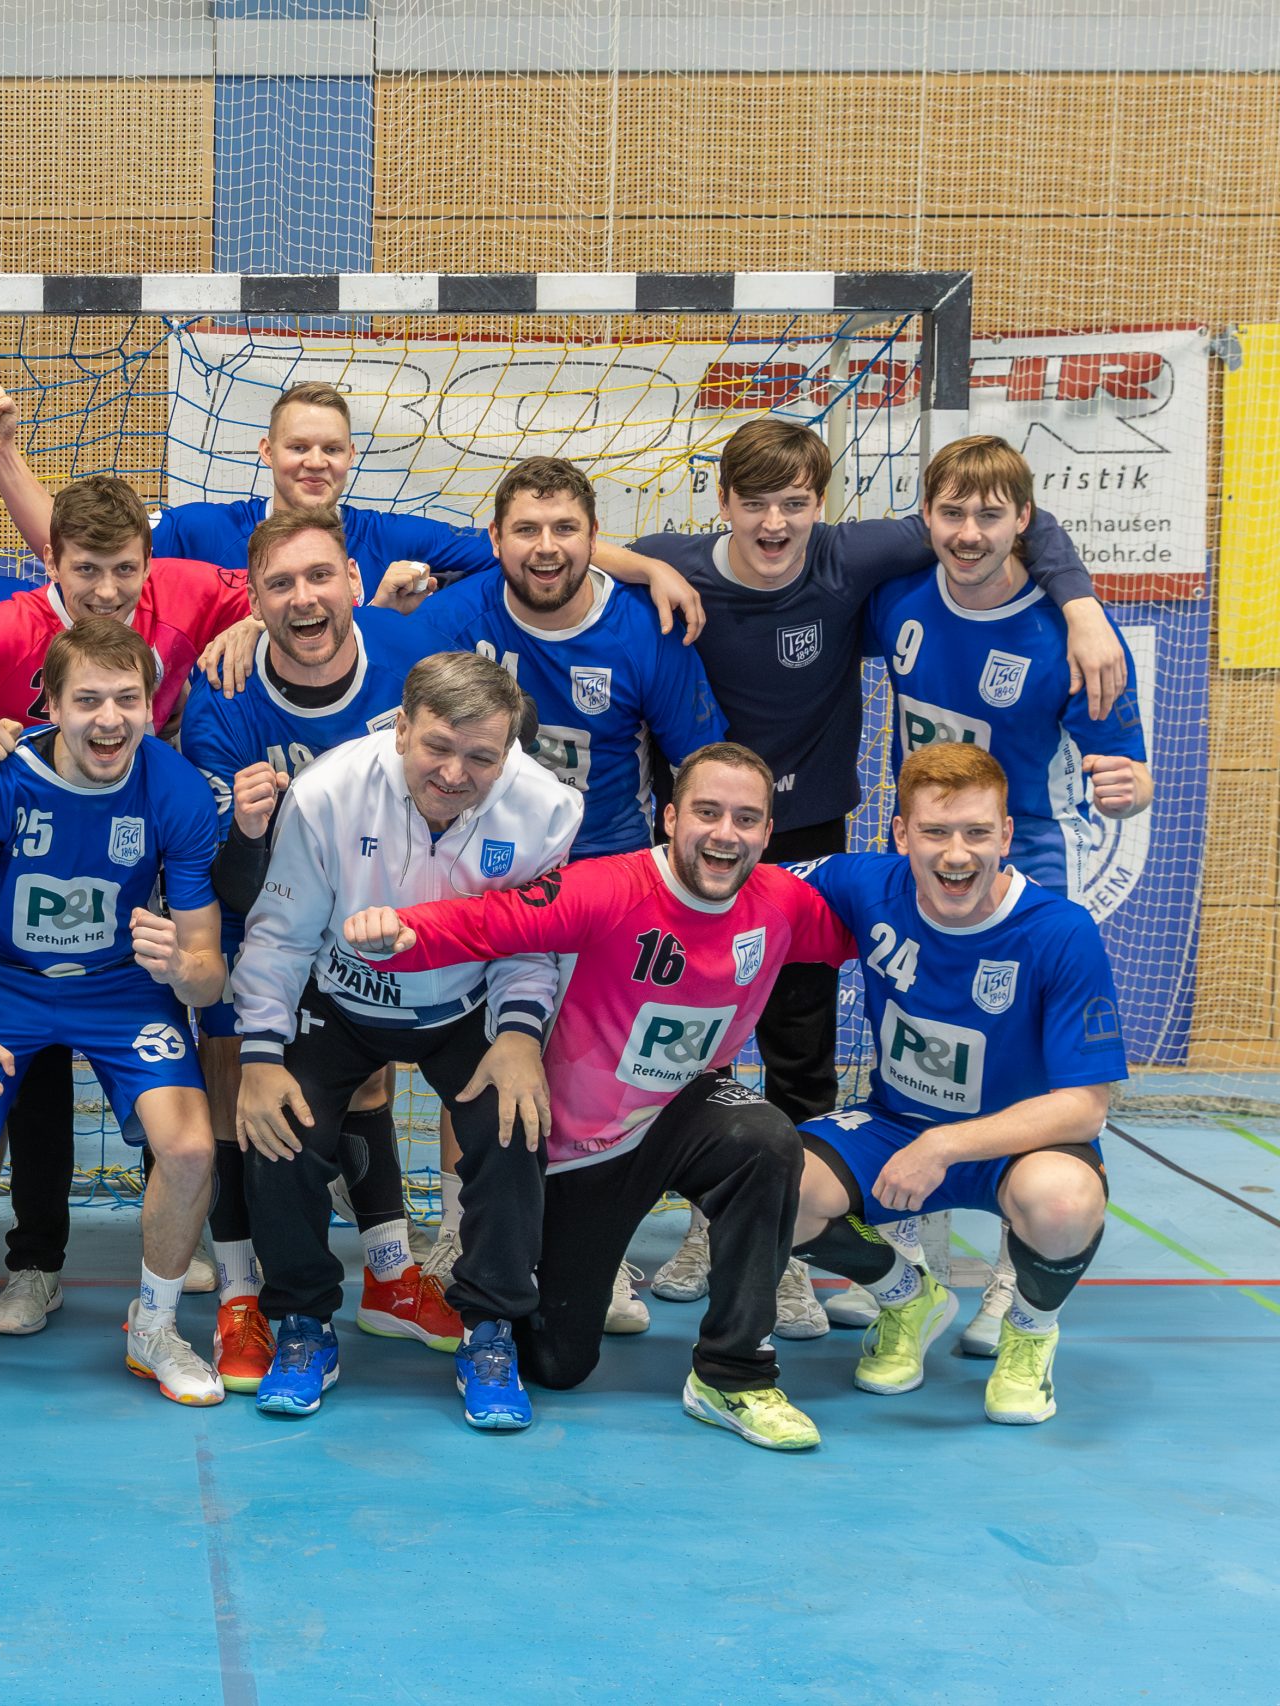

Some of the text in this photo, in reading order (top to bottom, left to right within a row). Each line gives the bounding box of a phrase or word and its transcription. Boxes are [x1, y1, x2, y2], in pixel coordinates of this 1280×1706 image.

[1061, 516, 1172, 532] enhausen
[785, 627, 815, 657] TSG
[796, 645, 815, 662] 1846
[893, 619, 924, 676] 9
[989, 661, 1020, 687] TSG
[577, 675, 605, 698] TSG
[993, 685, 1014, 699] 1846
[117, 825, 139, 849] TSG
[360, 836, 378, 858] TF
[121, 845, 139, 858] 1846
[487, 847, 510, 867] TSG
[26, 886, 105, 930] P&I
[26, 930, 105, 946] Rethink HR
[631, 928, 687, 987] 16
[867, 922, 920, 993] 24
[328, 959, 401, 1007] MANN
[982, 970, 1013, 994] TSG
[990, 989, 1008, 1004] 1846
[638, 1016, 723, 1064] P&I
[890, 1017, 970, 1085] P&I
[632, 1063, 683, 1081] Rethink
[889, 1066, 966, 1103] Rethink HR
